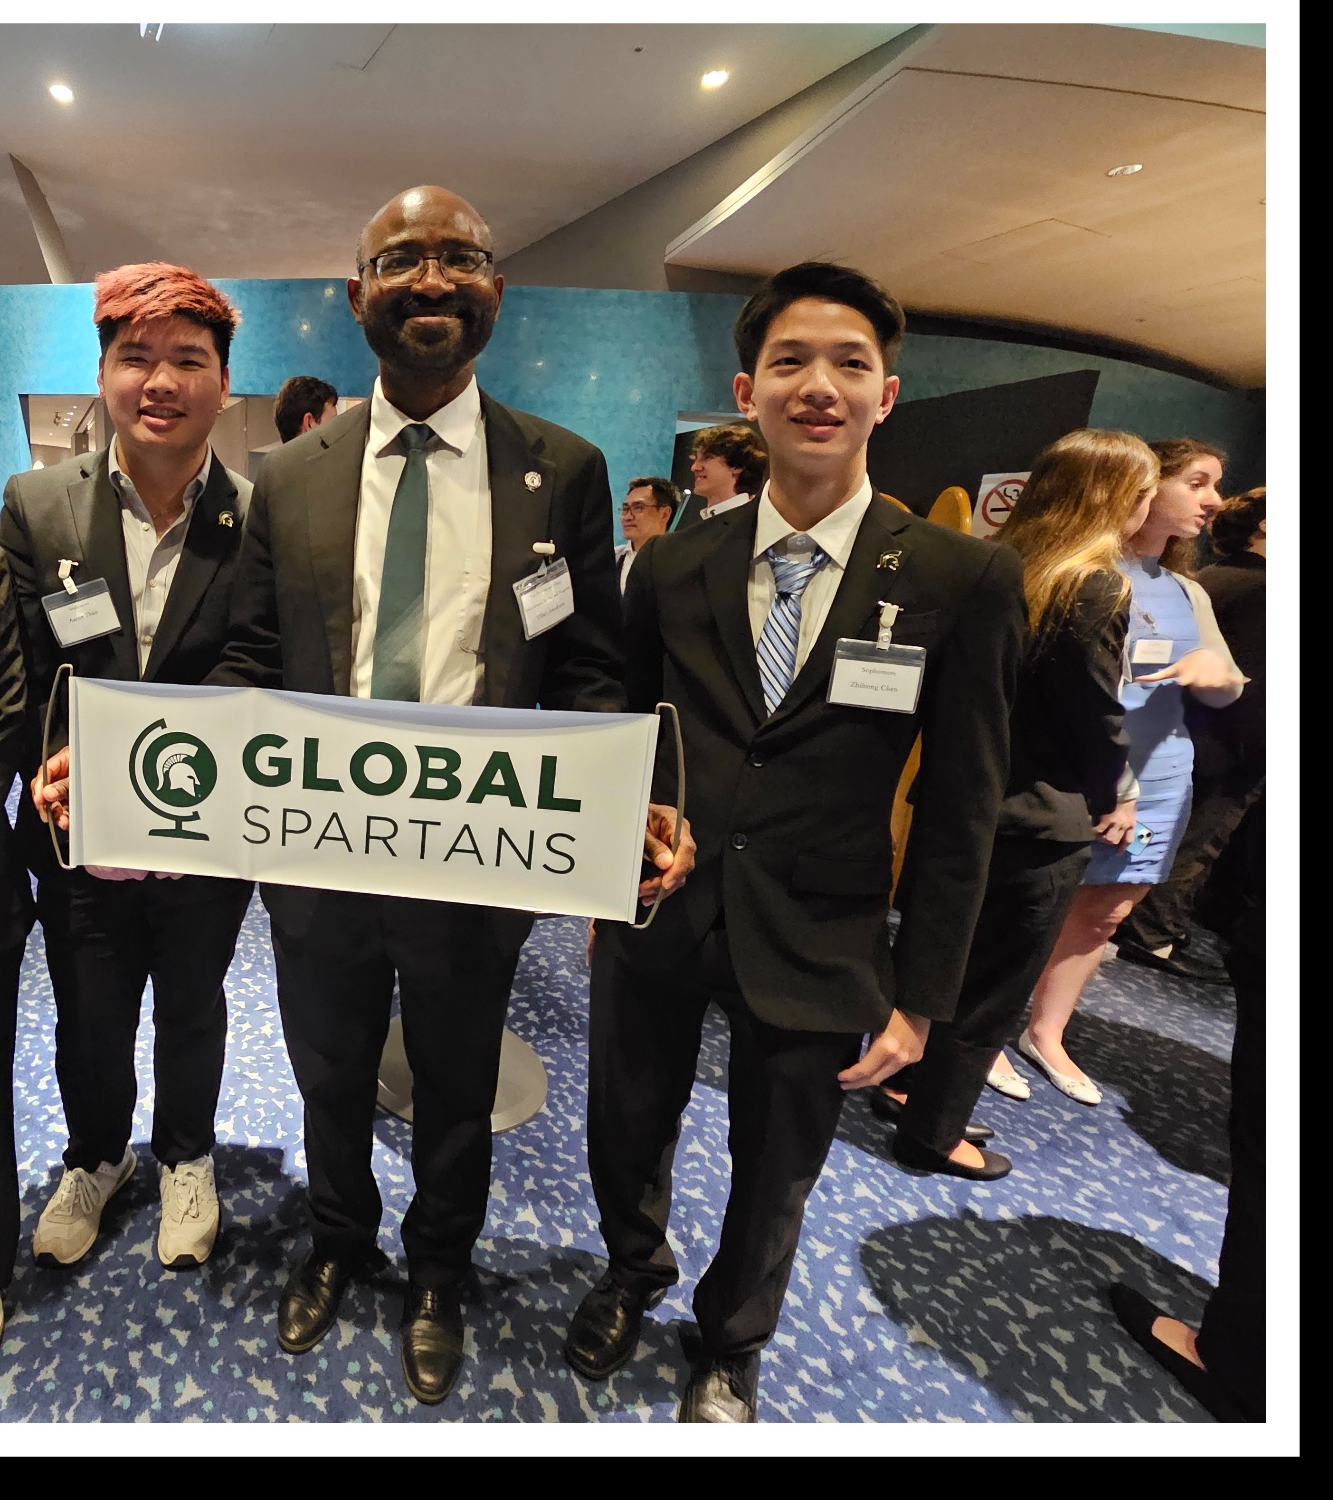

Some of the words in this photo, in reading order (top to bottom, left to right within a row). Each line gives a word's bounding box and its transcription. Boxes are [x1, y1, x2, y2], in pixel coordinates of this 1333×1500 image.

[880, 684, 899, 693] Chen
[242, 733, 582, 813] GLOBAL
[241, 804, 578, 875] SPARTANS
